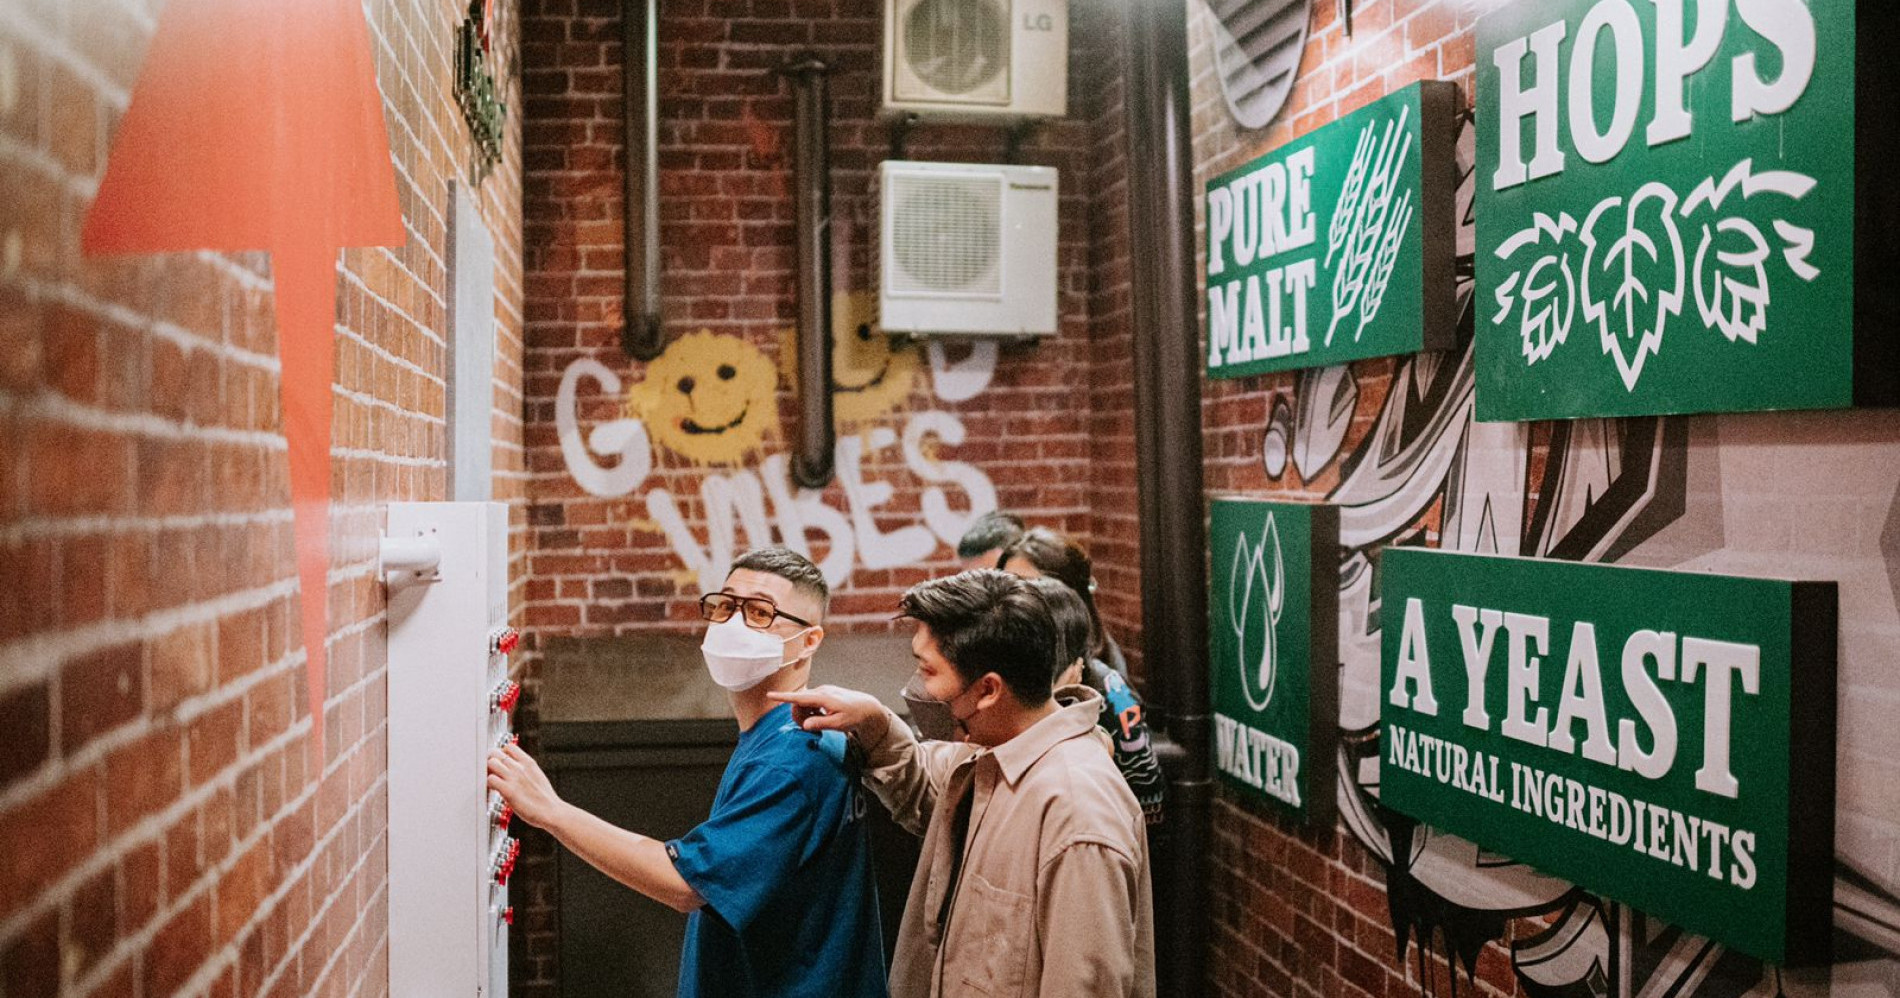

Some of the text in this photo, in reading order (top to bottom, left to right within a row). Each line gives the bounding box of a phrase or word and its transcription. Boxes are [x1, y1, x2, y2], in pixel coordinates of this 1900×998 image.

[1023, 13, 1052, 31] LG
[1493, 0, 1817, 190] HOPS
[1208, 146, 1315, 276] PURE
[1208, 259, 1316, 368] MALT
[646, 410, 998, 592] VIBES
[1214, 712, 1301, 808] WATER
[1390, 597, 1760, 799] A YEAST
[1389, 724, 1757, 890] NATURAL INGREDIENTS
